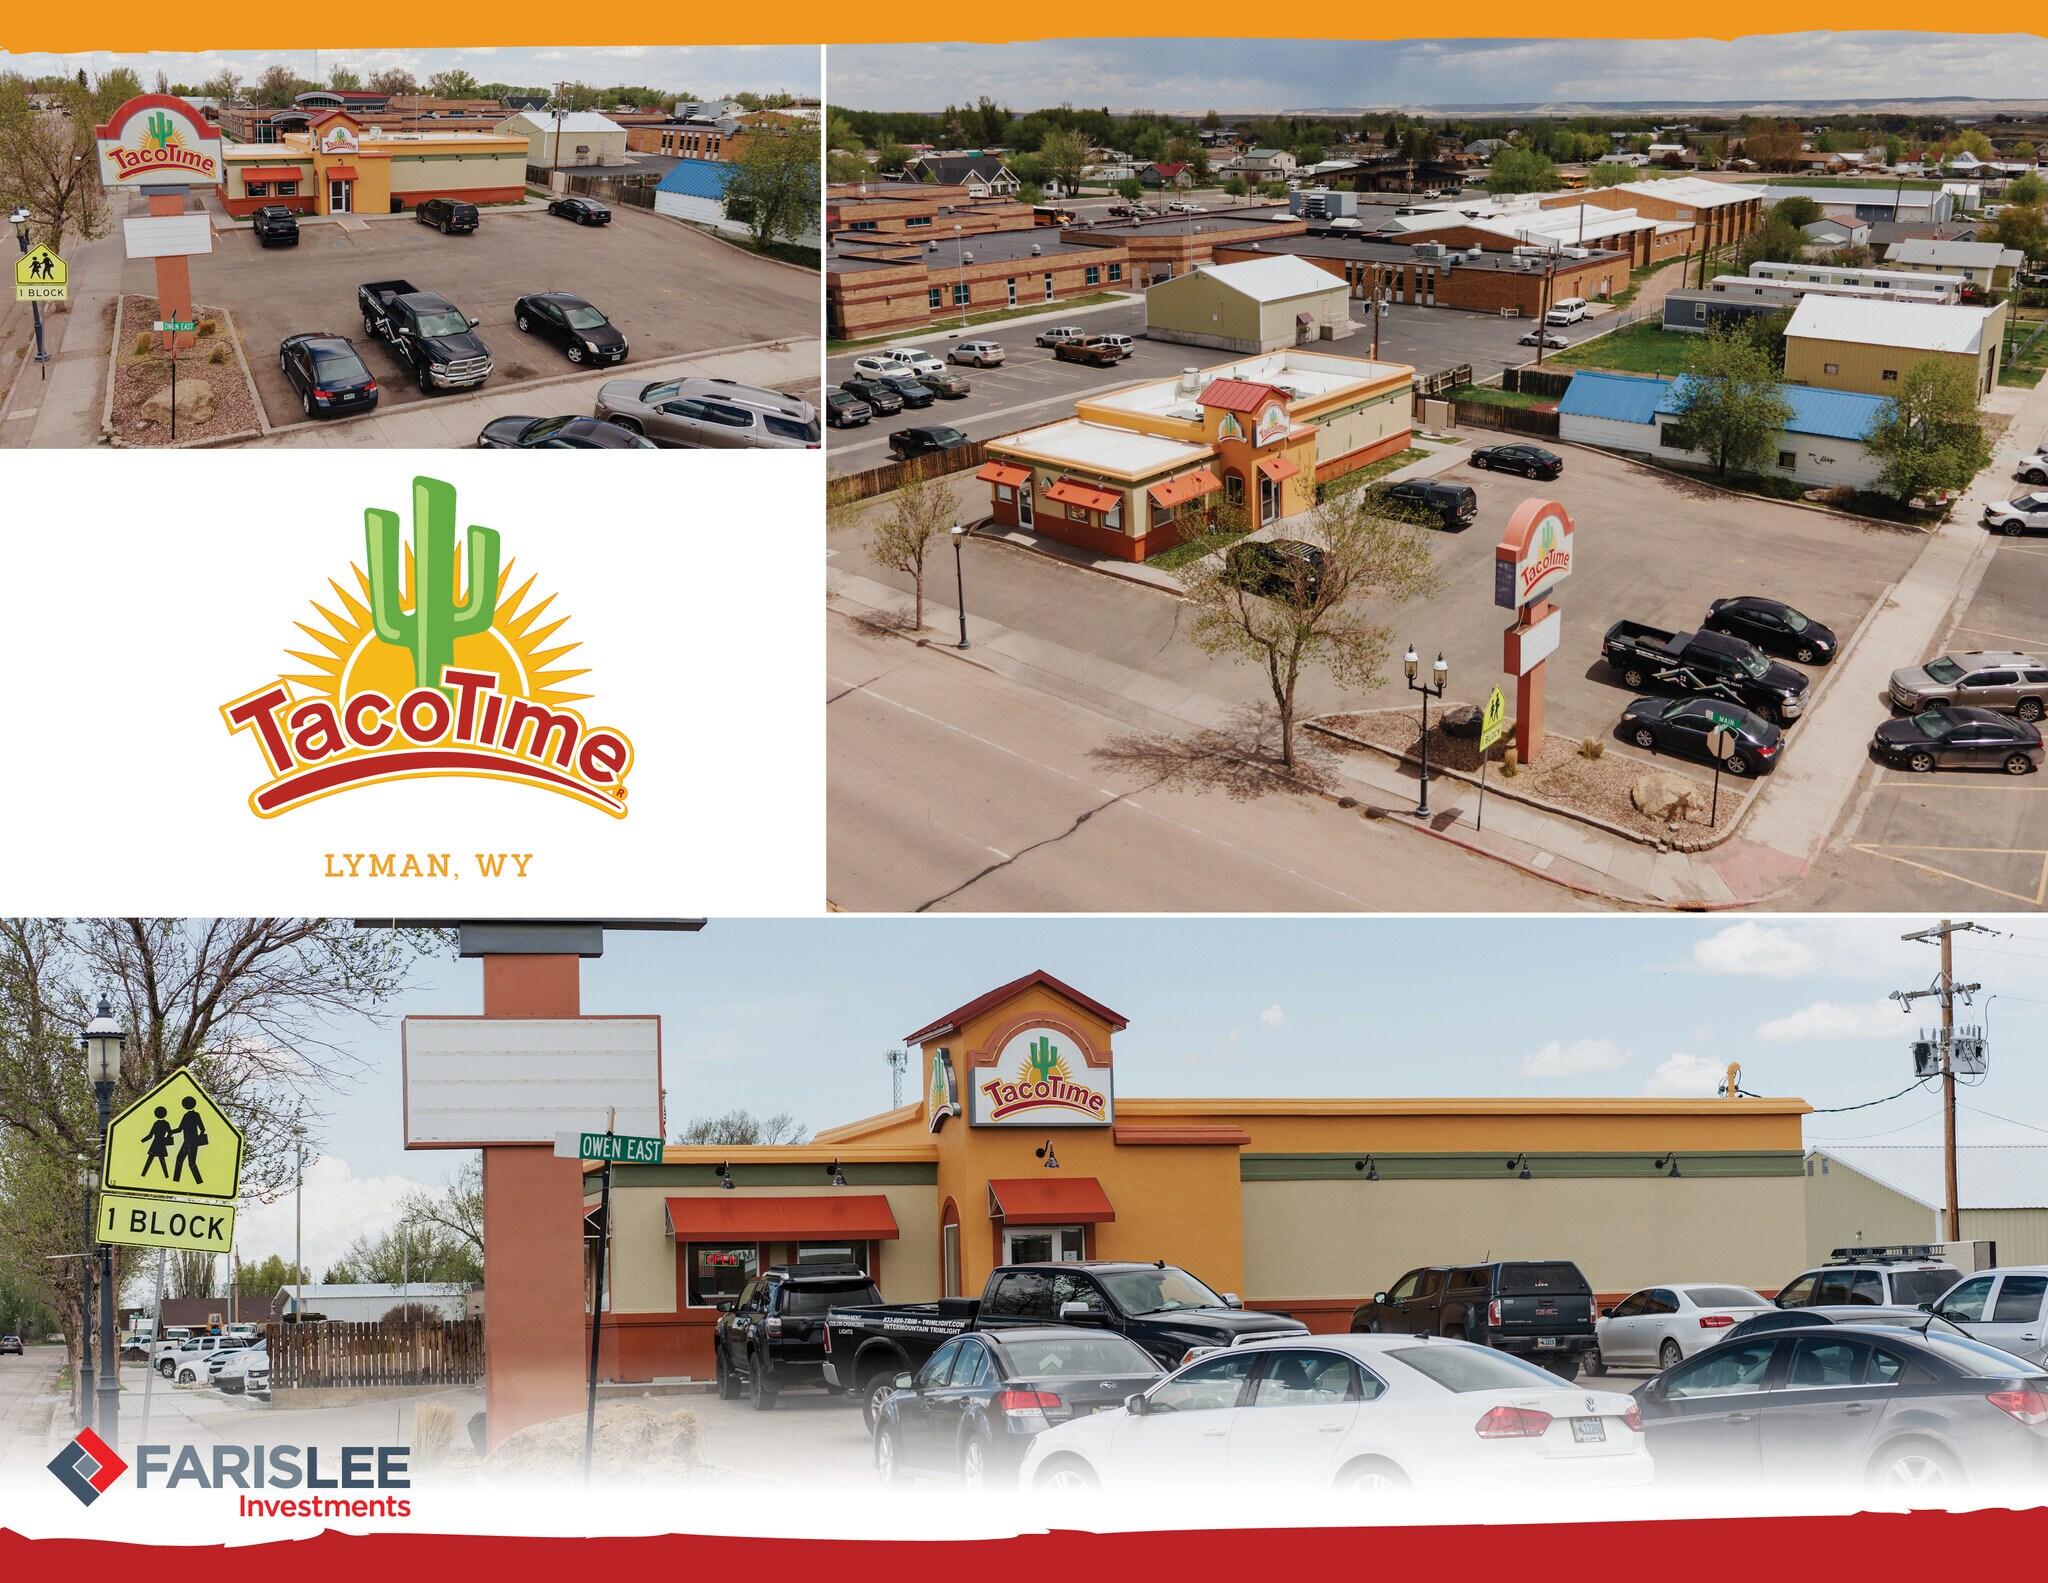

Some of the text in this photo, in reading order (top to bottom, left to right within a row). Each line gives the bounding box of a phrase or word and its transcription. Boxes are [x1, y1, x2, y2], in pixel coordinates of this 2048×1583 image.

[324, 140, 357, 150] TacoTime
[108, 143, 214, 171] TacoTime
[19, 289, 64, 297] 1 BLOCK
[180, 322, 194, 331] EAST
[1259, 422, 1288, 439] TacoTime
[1520, 548, 1570, 587] TacoTime
[1718, 715, 1735, 727] MAIN
[983, 1075, 1104, 1111] TacoTime
[582, 1135, 661, 1162] OWEN EAST
[108, 1207, 226, 1241] 1 BLOCK
[705, 1253, 738, 1266] OPEN
[1535, 1308, 1558, 1316] GMC
[883, 1323, 962, 1335] INTERMOUNTAIN TRIMLIGHT
[922, 1318, 966, 1329] TRIMLIGHT.COM
